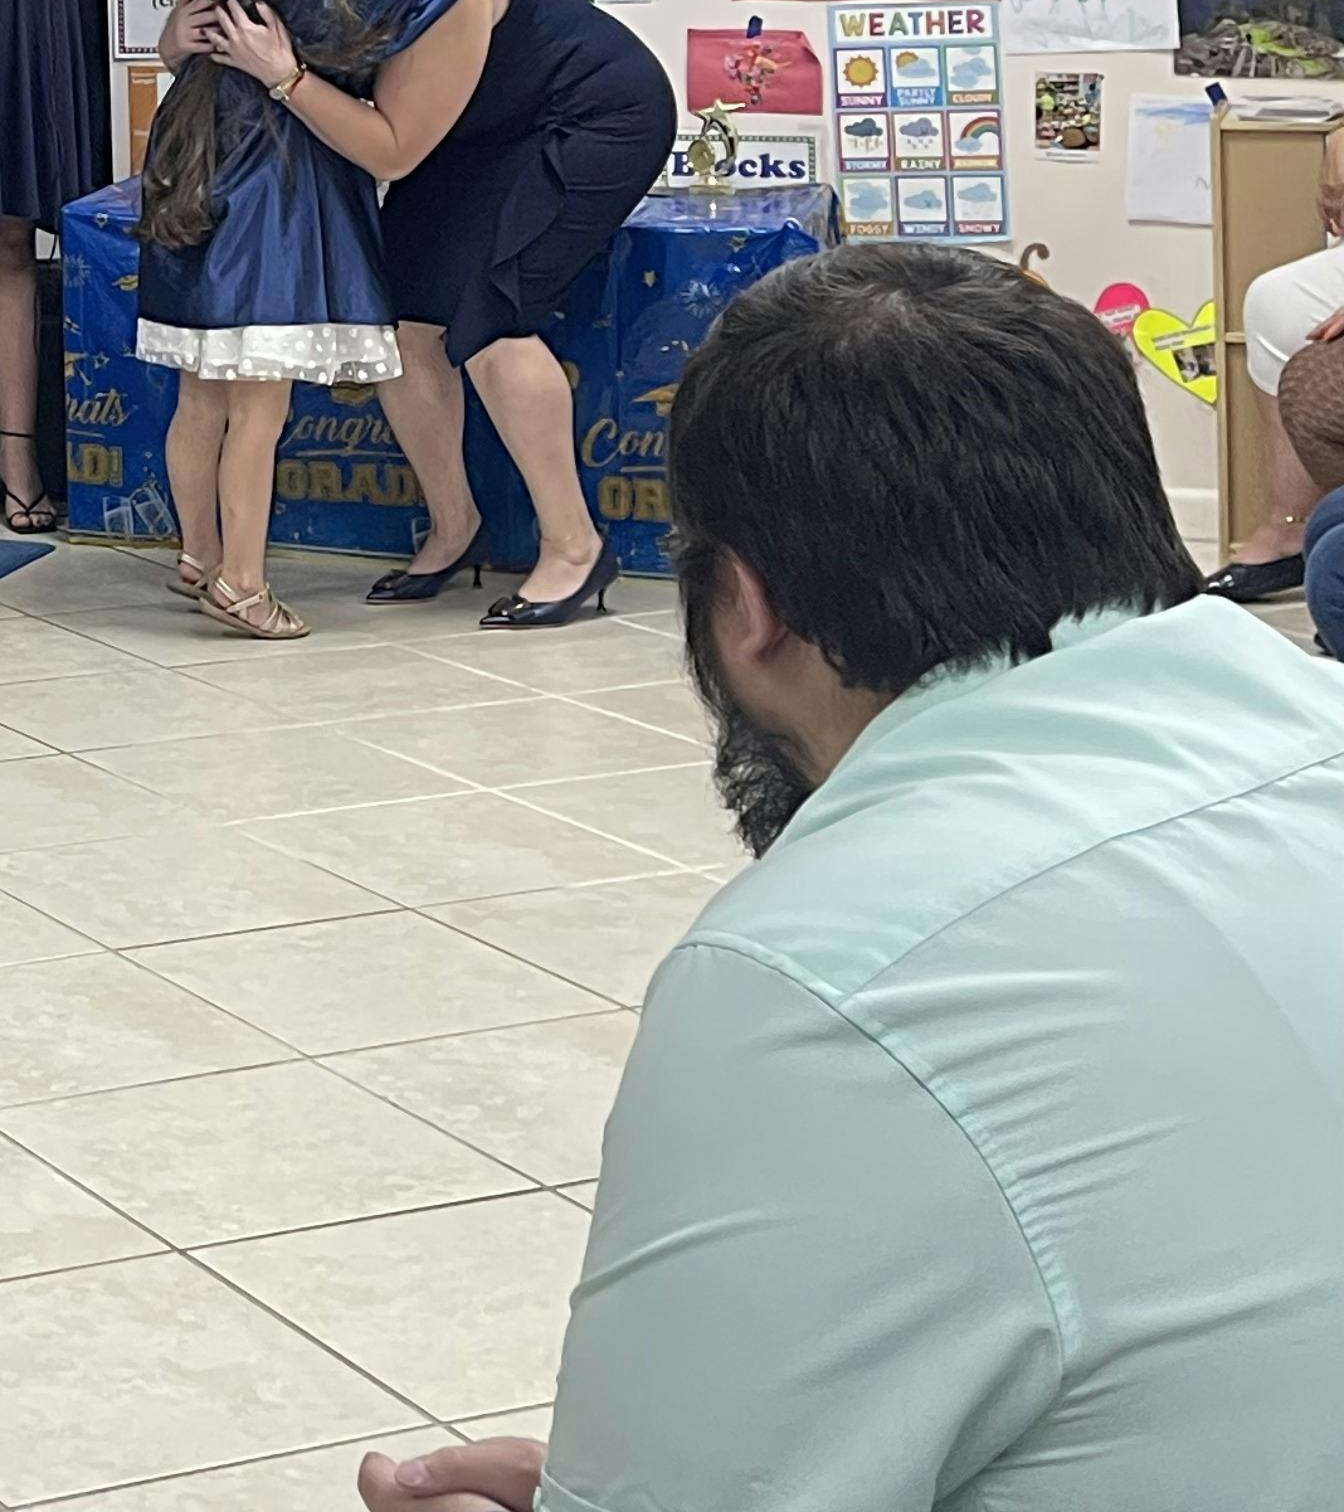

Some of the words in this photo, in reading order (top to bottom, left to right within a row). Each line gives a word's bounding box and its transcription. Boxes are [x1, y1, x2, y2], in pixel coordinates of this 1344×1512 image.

[839, 9, 986, 37] WEATHER
[840, 95, 883, 106] SUNNY
[952, 93, 993, 104] CLOUDY
[900, 159, 942, 170] RAINY
[848, 224, 889, 235] FOGGY
[903, 223, 946, 234] WINDY
[958, 223, 1000, 234] SNOWY
